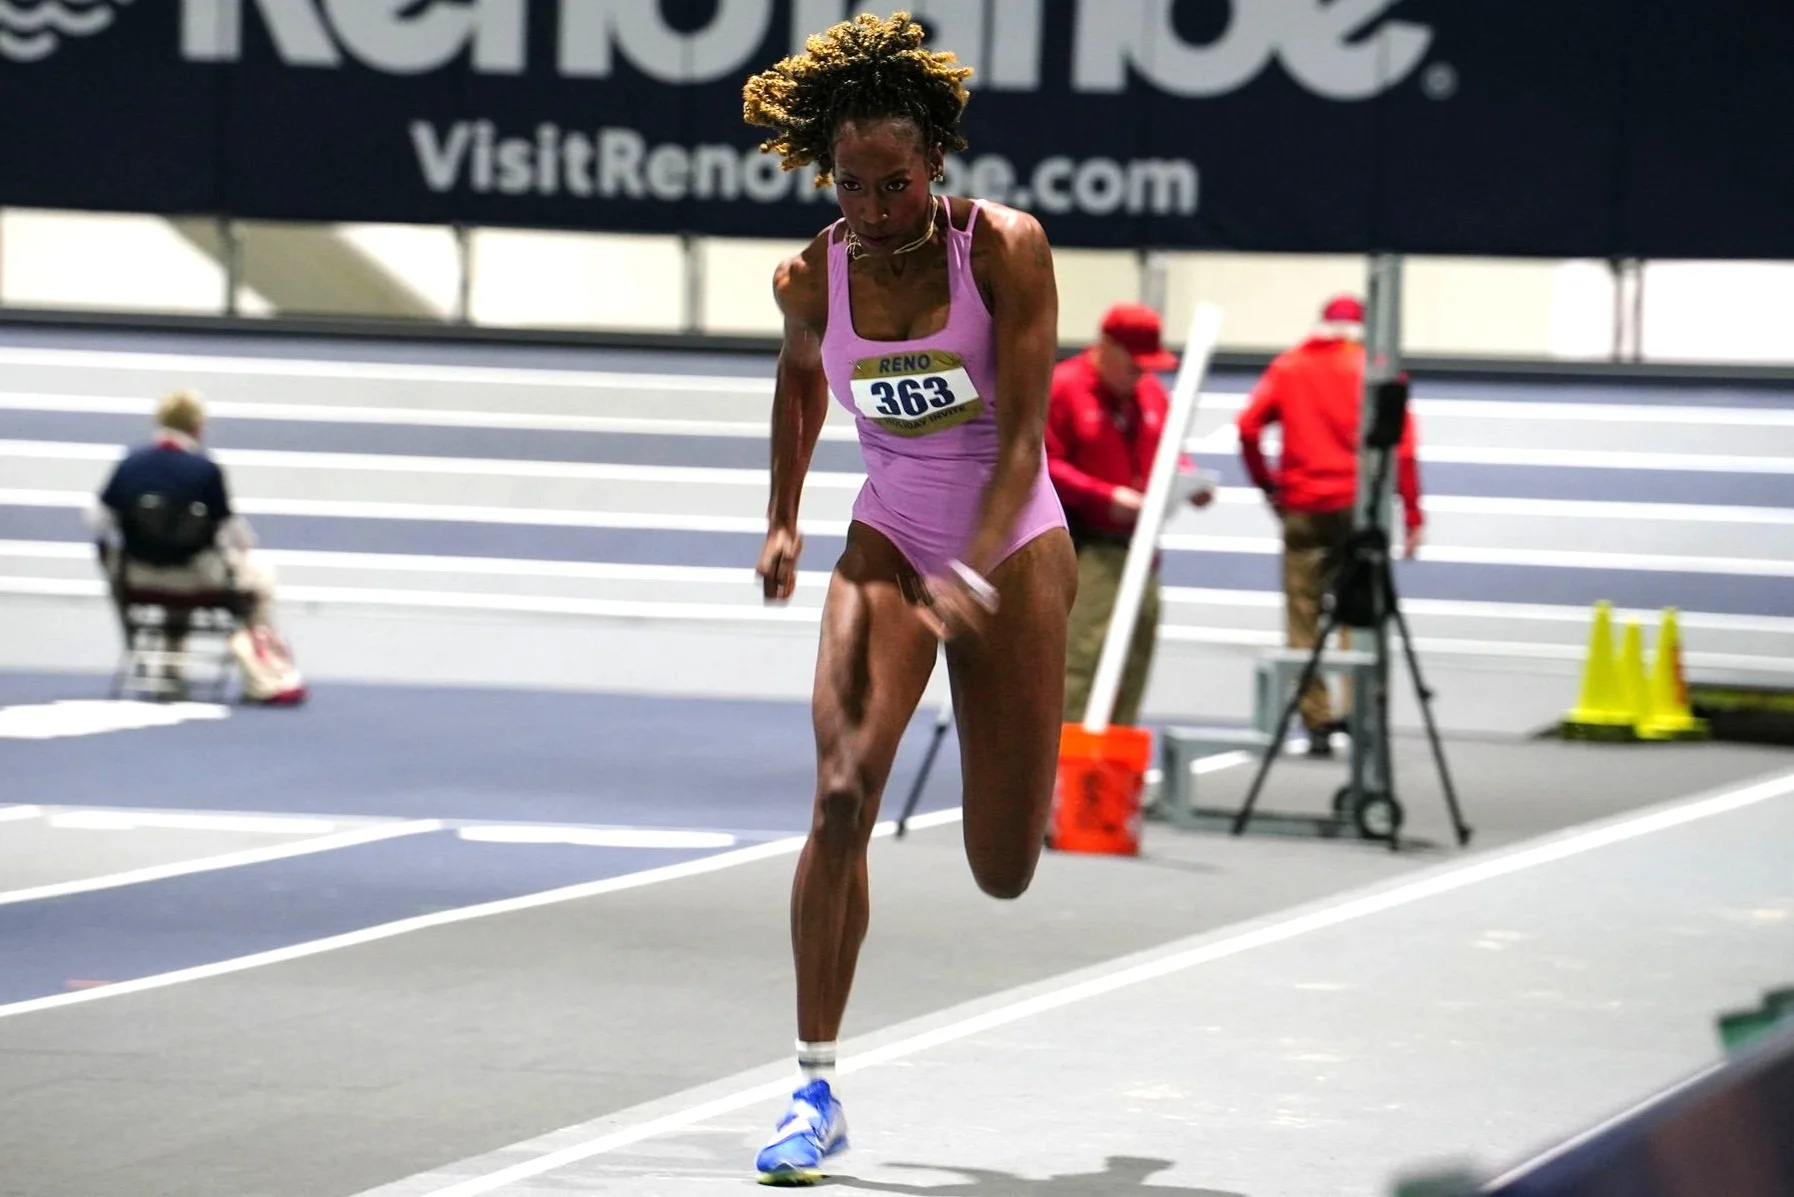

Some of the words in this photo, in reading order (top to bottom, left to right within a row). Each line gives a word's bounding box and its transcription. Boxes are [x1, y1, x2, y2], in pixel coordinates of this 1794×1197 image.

[409, 118, 1198, 215] VisitRenoe.com
[879, 354, 931, 373] RENO
[870, 376, 956, 416] 363
